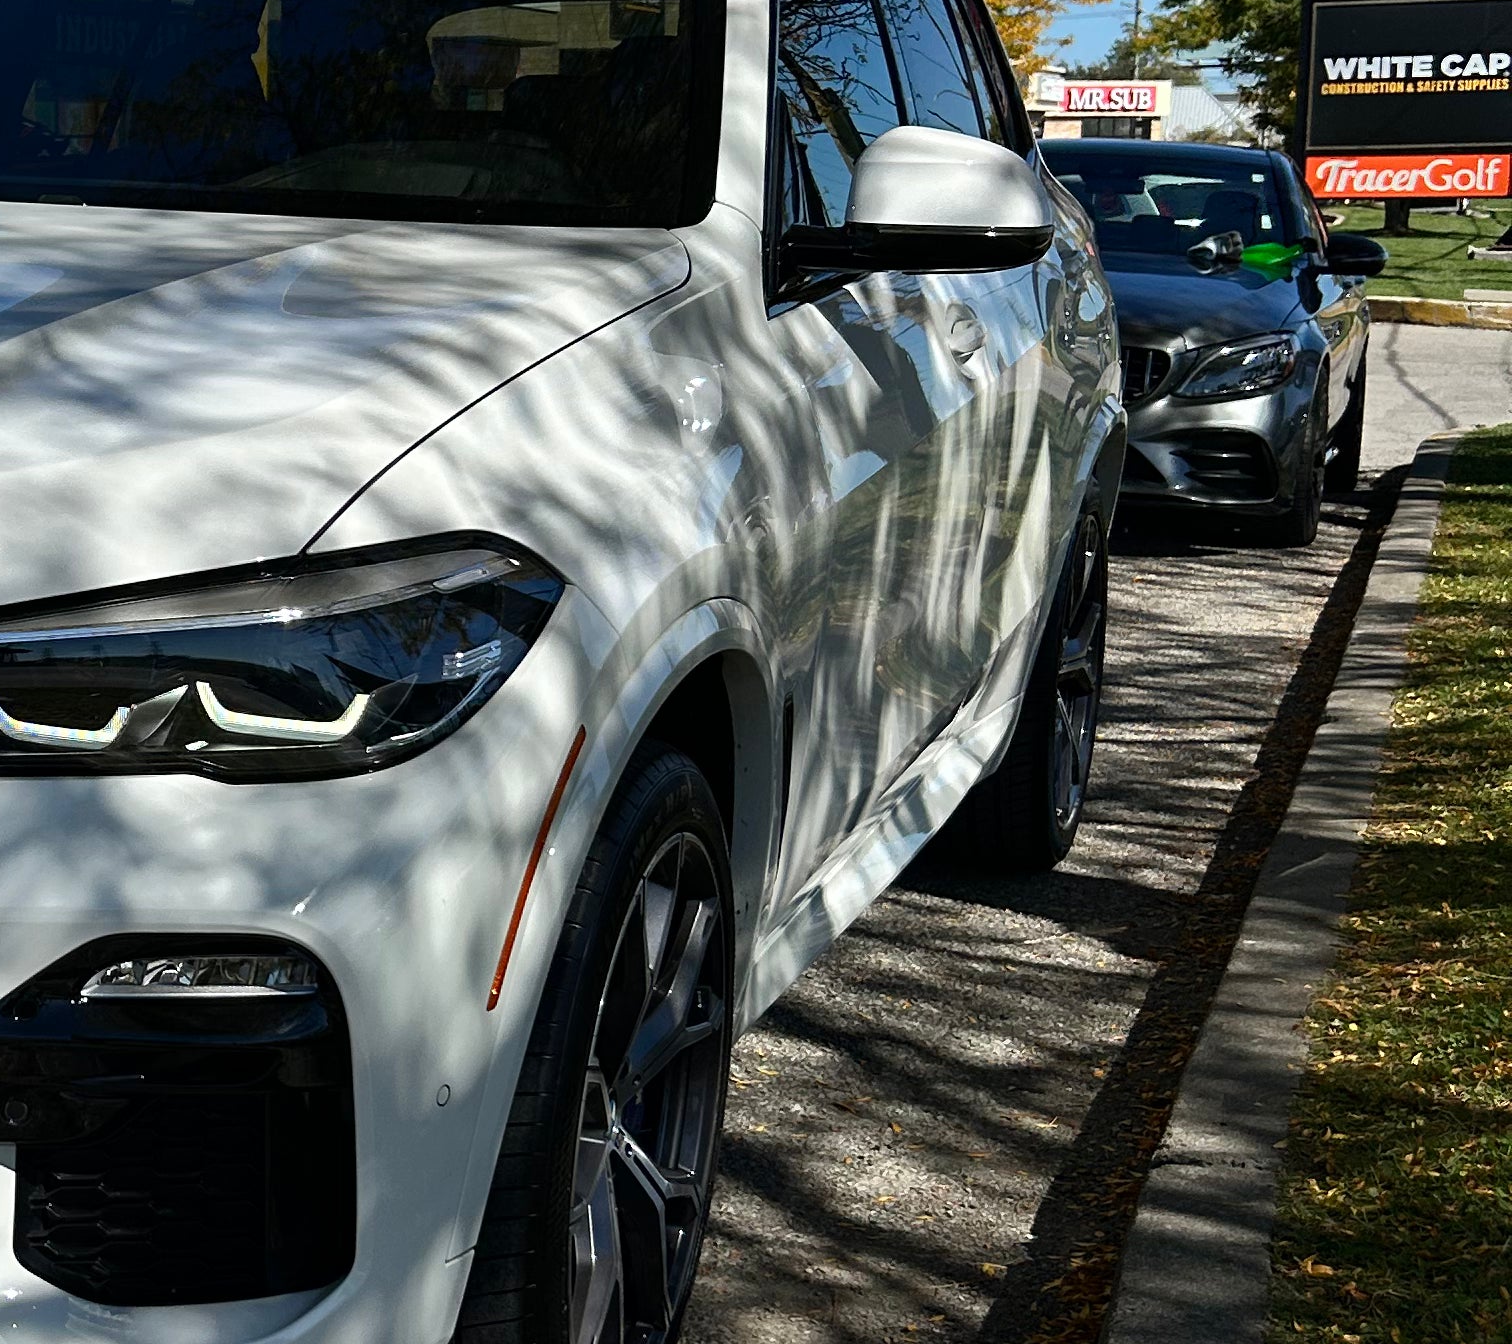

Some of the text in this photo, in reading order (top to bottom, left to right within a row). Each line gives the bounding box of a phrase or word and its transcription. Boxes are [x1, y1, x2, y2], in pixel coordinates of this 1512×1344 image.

[1323, 55, 1433, 80] WHITE
[1321, 78, 1509, 95] CONSTRUCTION & SAFETY SUPPLIES
